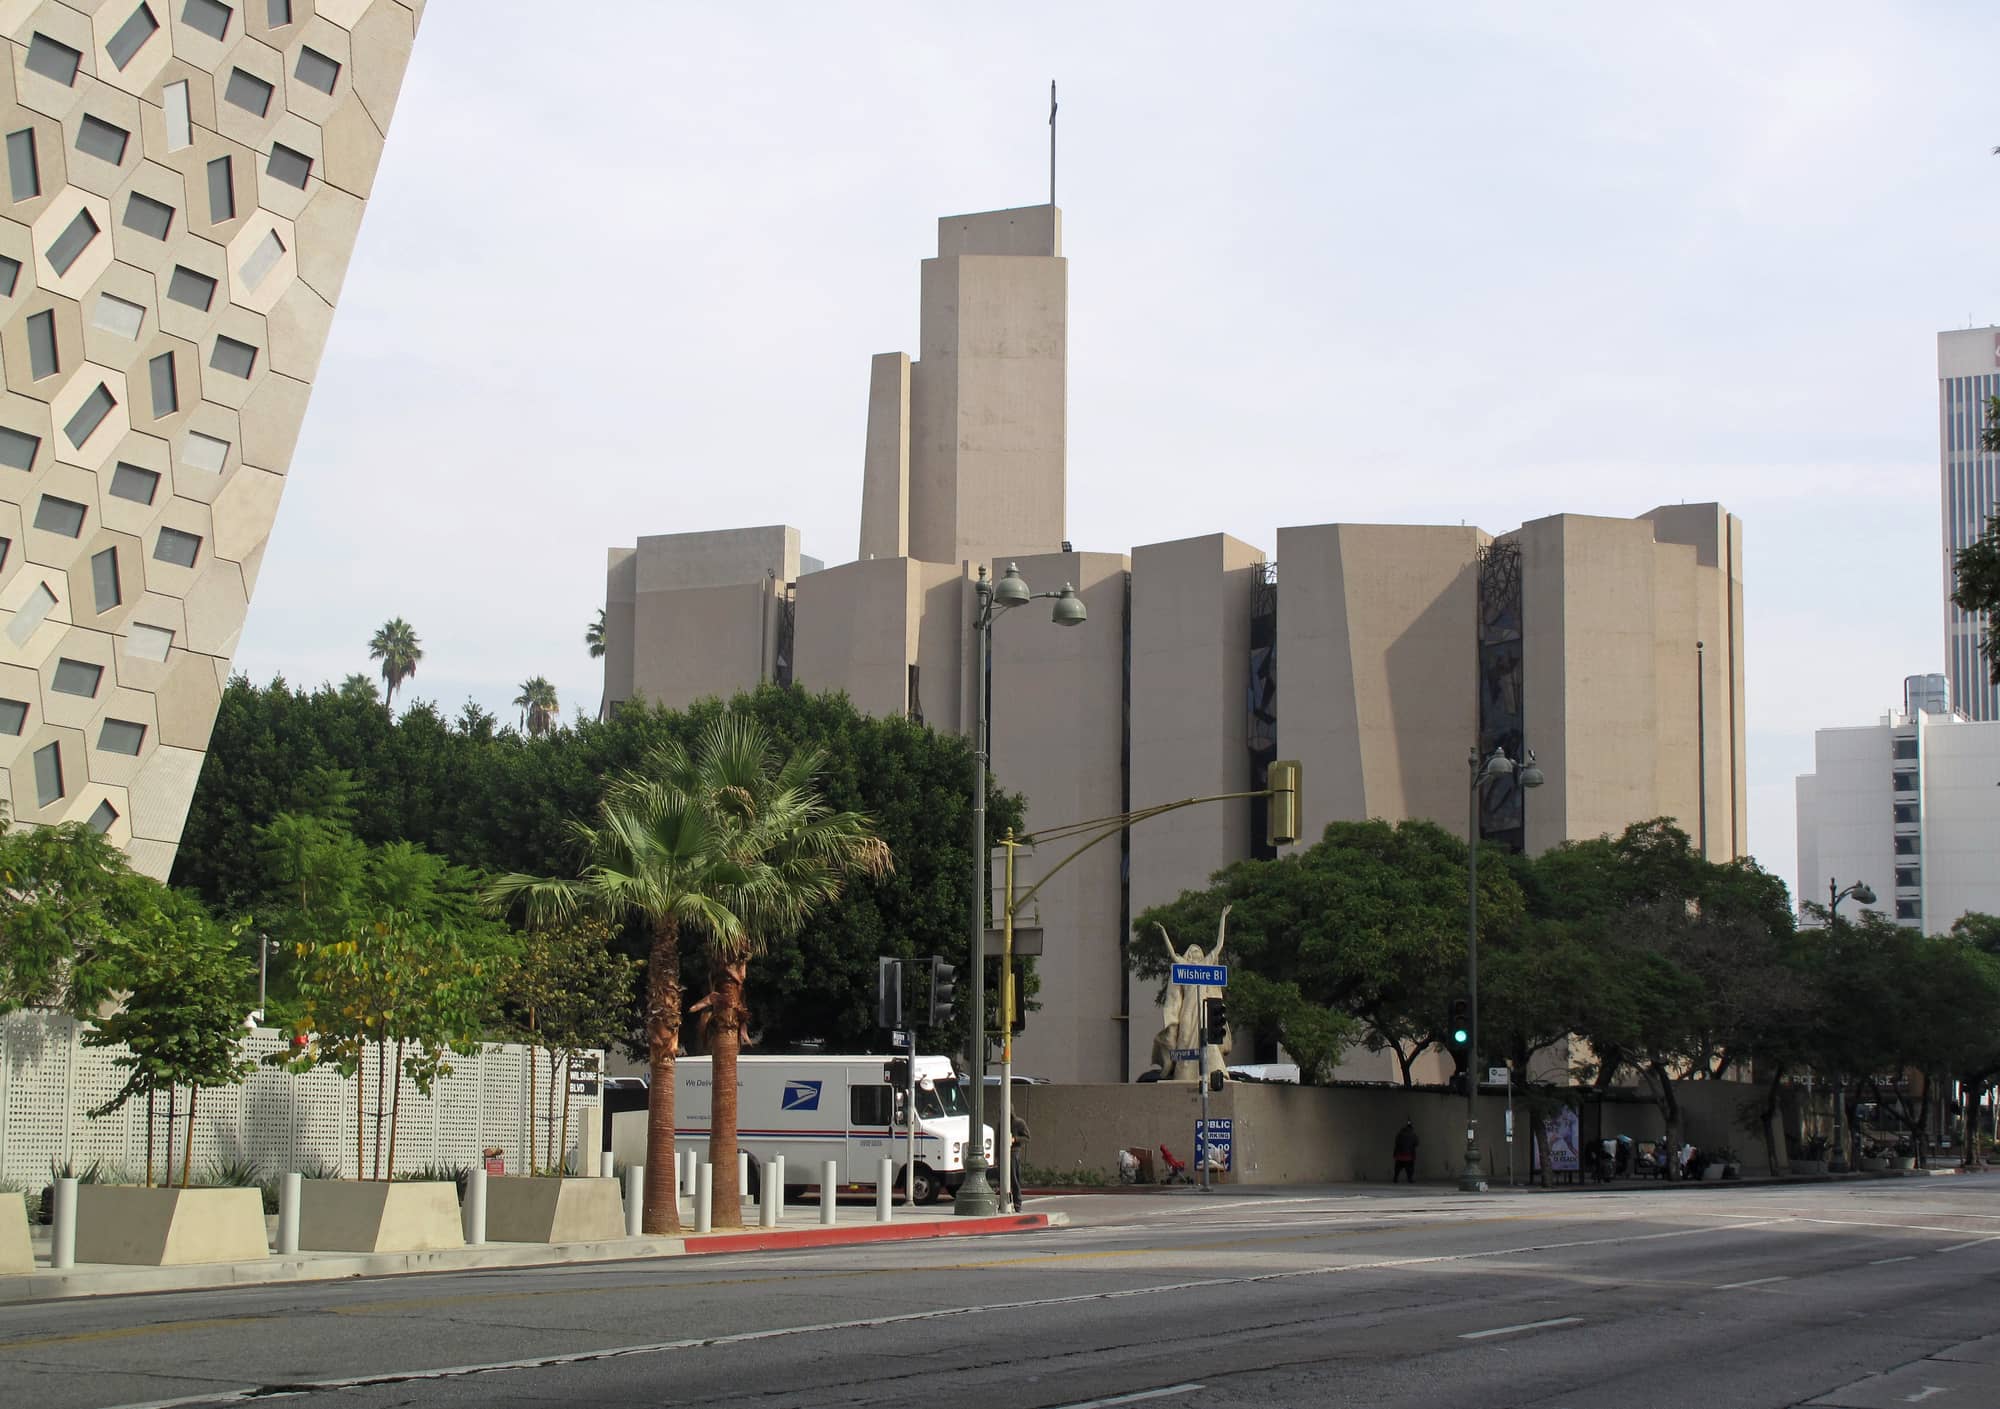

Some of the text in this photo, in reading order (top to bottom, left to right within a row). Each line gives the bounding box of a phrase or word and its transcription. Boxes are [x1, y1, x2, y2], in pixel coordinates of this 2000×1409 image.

[1177, 968, 1223, 981] Wilshire Bl
[569, 1071, 597, 1080] WILSHIRE
[696, 1079, 713, 1087] Deliv
[569, 1083, 585, 1093] BLVD
[1197, 1120, 1231, 1129] PBLIC
